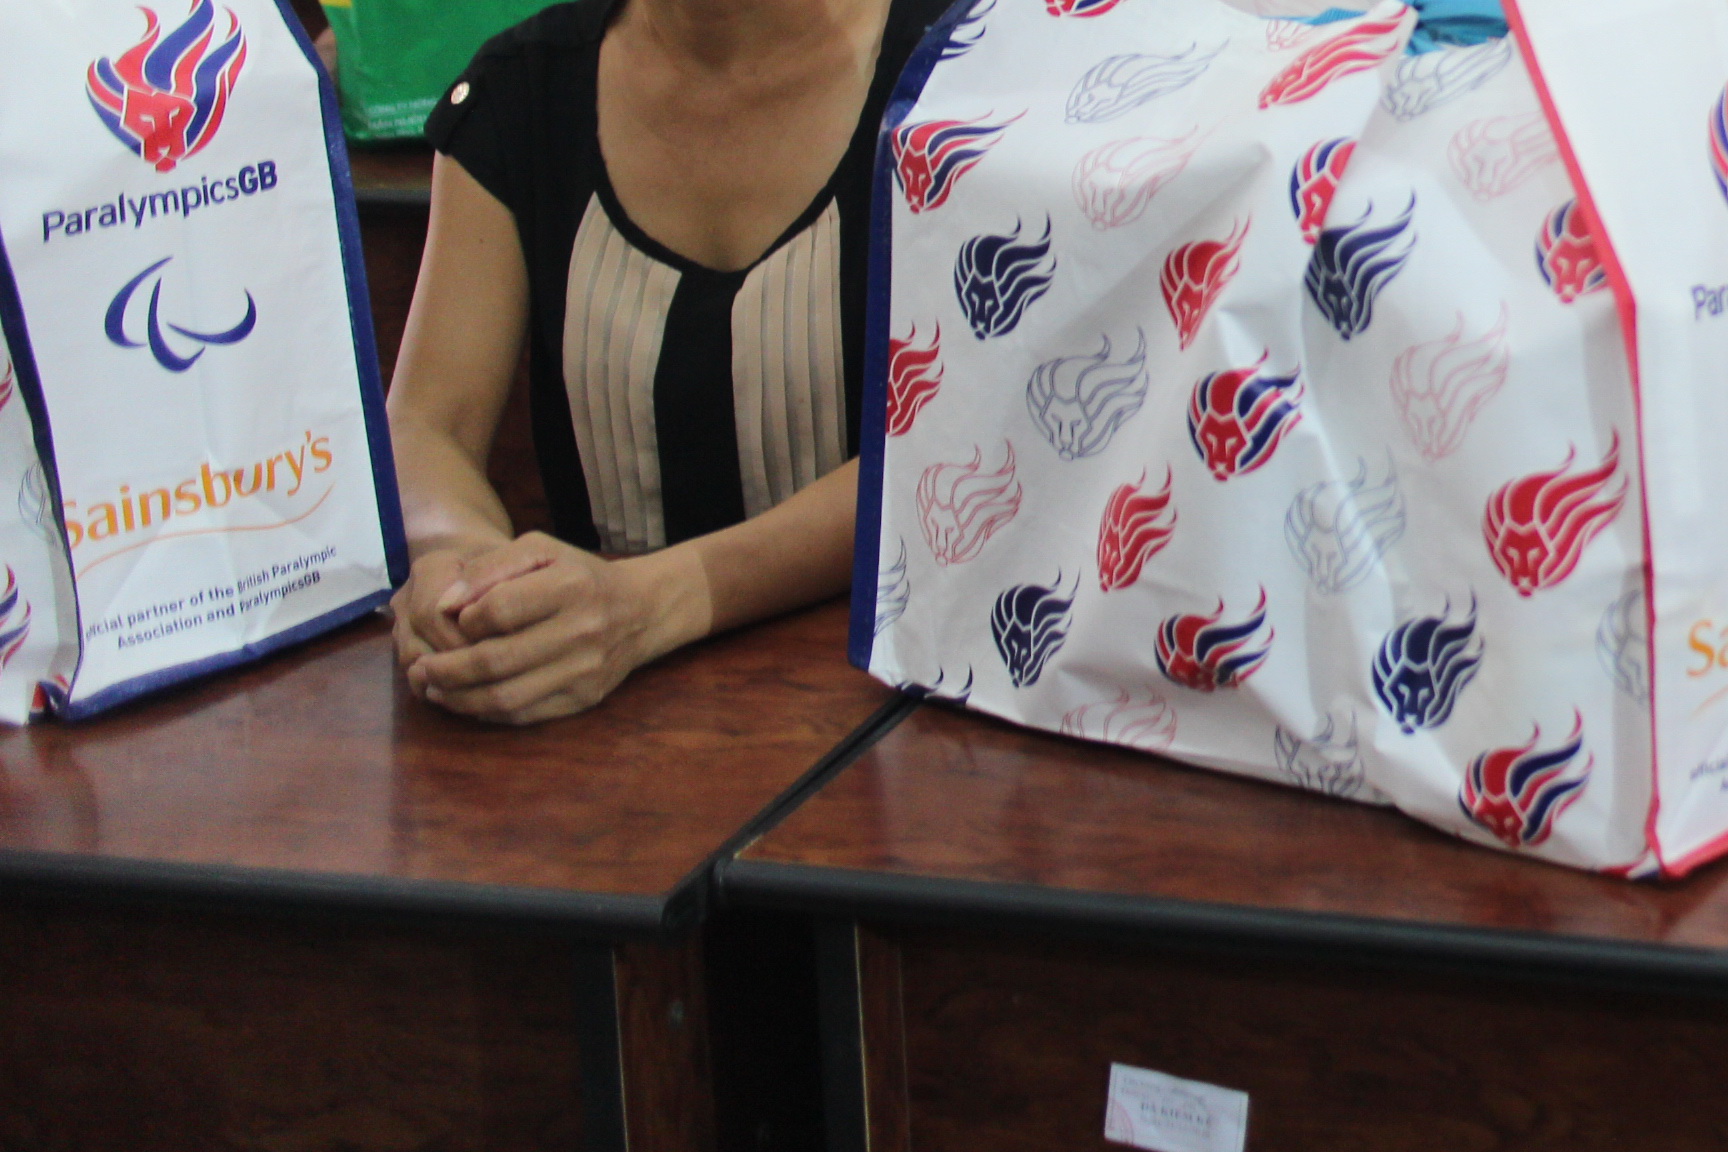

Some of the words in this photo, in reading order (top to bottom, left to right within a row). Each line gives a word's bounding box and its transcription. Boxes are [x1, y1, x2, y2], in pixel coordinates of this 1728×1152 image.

[42, 159, 279, 244] ParalympicsGB
[62, 429, 333, 550] Sainsbury's
[117, 614, 203, 650] Association
[207, 603, 235, 623] and
[239, 569, 321, 614] ParalympicsGB
[127, 599, 184, 629] partner
[190, 590, 205, 607] of
[208, 586, 234, 602] the
[237, 569, 270, 594] British
[271, 544, 338, 579] Paralympic
